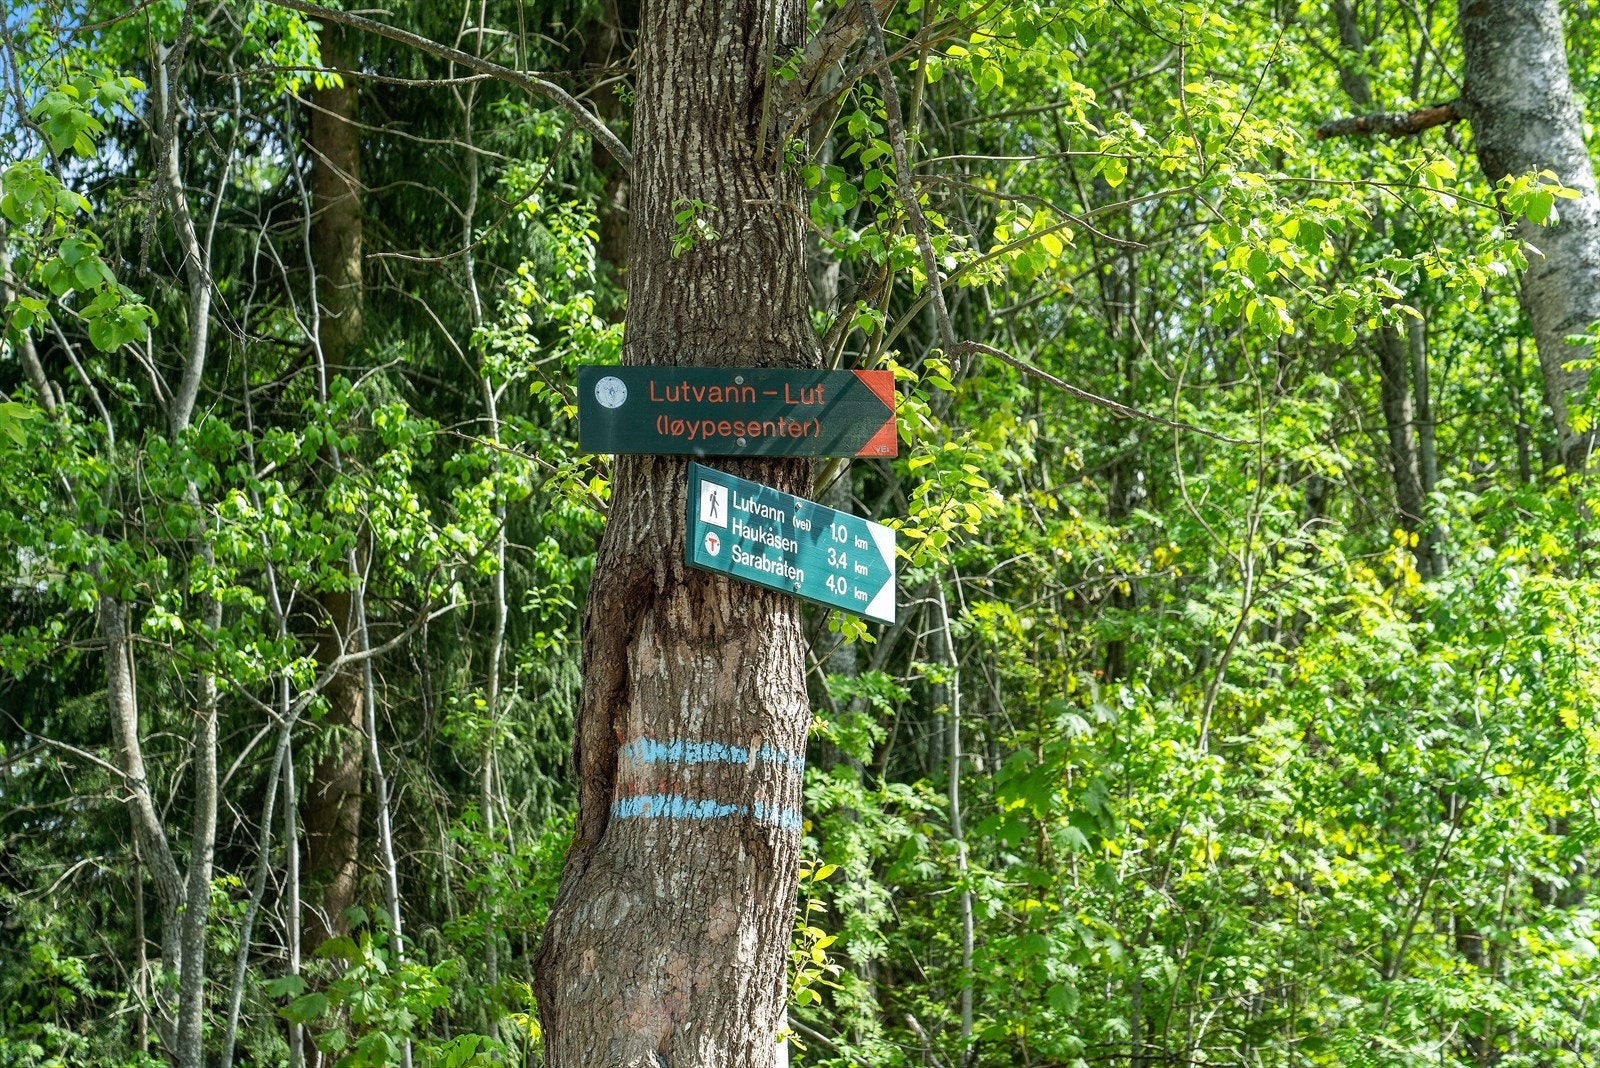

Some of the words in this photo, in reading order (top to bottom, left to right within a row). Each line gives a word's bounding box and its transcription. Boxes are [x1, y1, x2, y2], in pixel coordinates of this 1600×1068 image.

[649, 380, 756, 404] Lutvann
[784, 382, 825, 405] Lut
[655, 414, 821, 440] (løypesenter)
[732, 490, 785, 524] Lutvann
[792, 516, 812, 532] (vei)
[829, 522, 848, 544] 1,0
[854, 535, 869, 551] km
[708, 537, 718, 552] T
[731, 517, 798, 555] Haukåsen
[827, 547, 848, 570] 3,4
[854, 561, 869, 577] km
[731, 544, 804, 583] Sarabråten
[825, 573, 848, 595] 4,0
[854, 587, 869, 602] km
